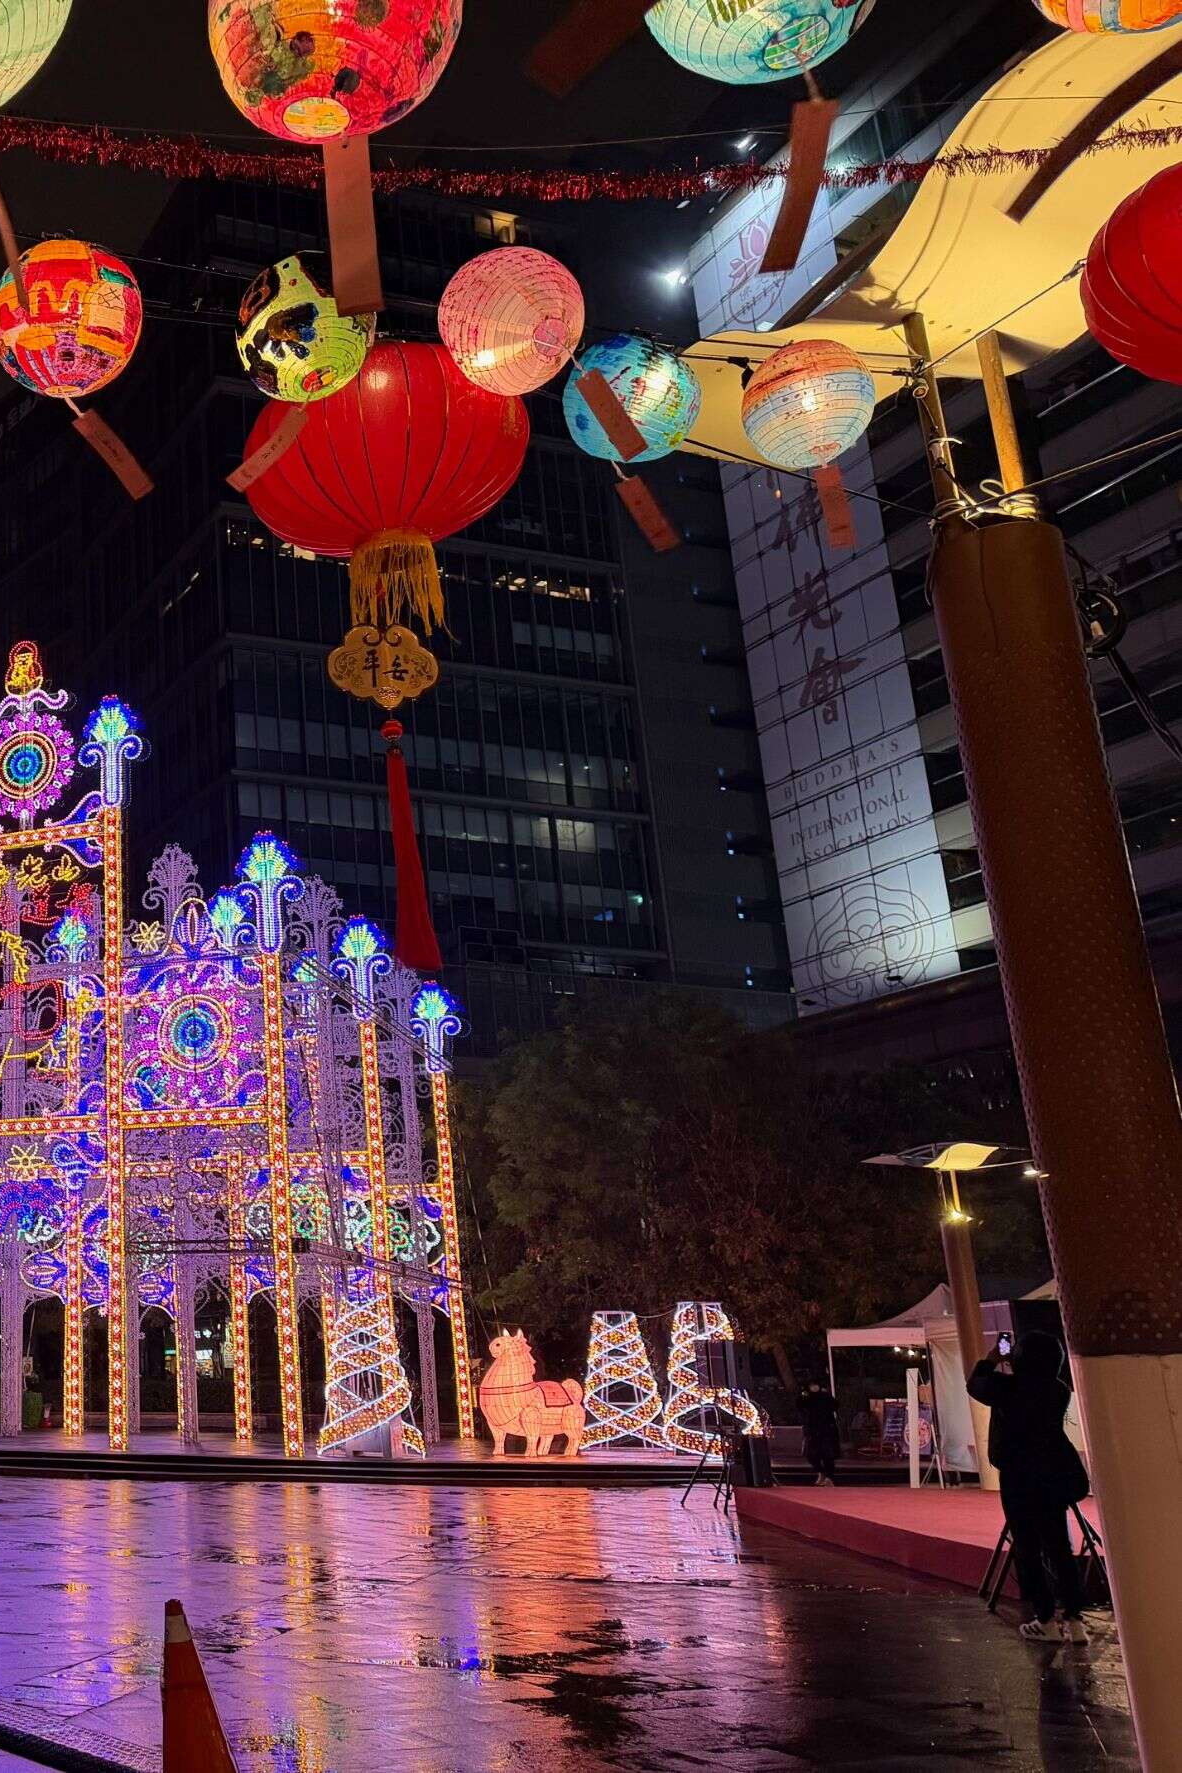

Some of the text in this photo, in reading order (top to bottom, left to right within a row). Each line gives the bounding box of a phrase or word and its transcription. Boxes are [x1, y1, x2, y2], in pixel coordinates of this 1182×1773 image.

[783, 737, 899, 800] BUDDHA'S
[791, 787, 910, 846] INTERNATIONAL
[796, 811, 913, 865] ASSOCIATION
